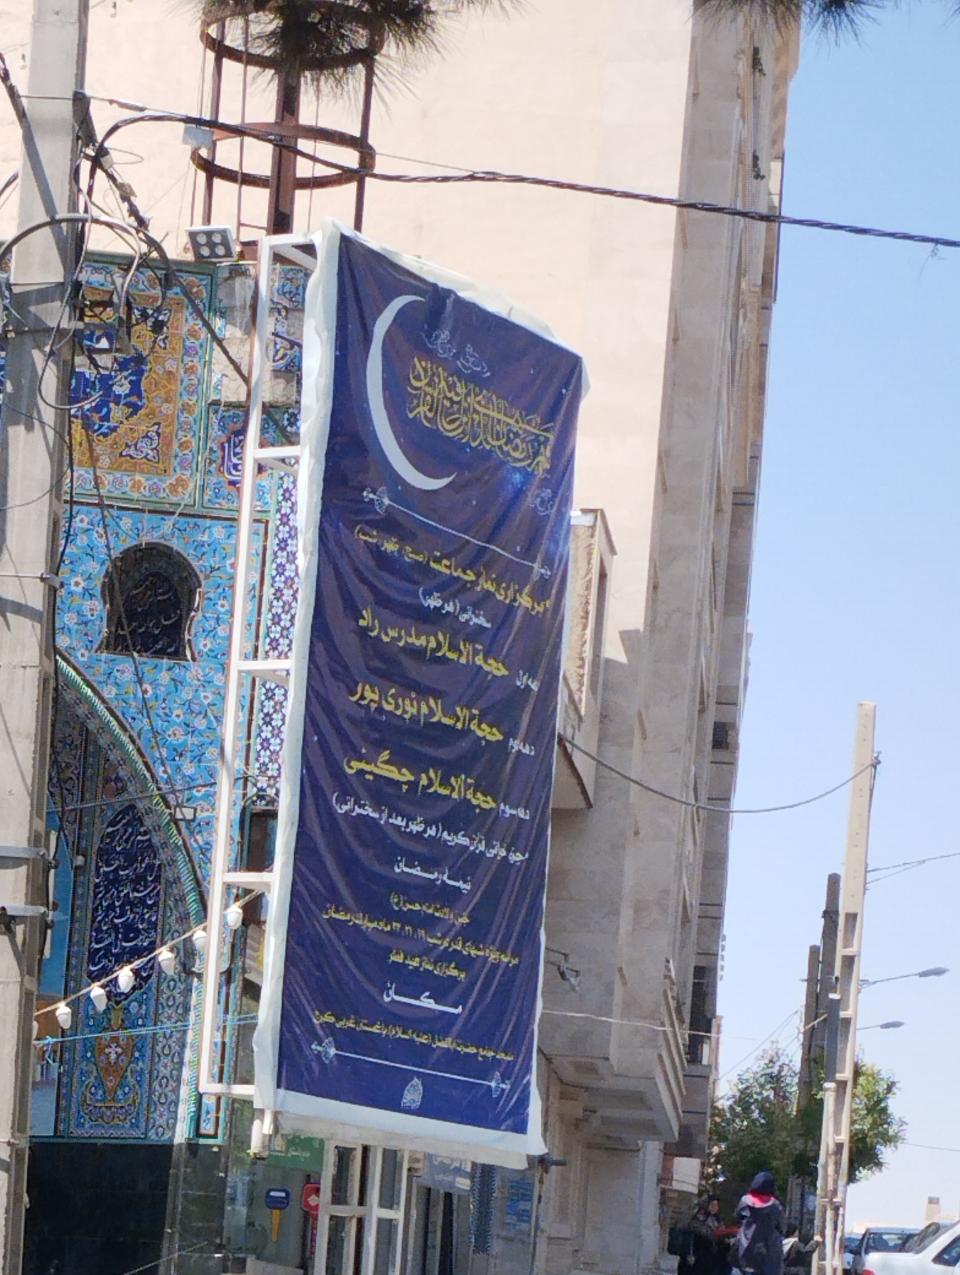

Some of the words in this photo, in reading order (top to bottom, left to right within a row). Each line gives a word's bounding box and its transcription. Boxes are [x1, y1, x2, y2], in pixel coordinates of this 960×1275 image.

[430, 551, 476, 587] جماعت
[427, 629, 473, 667] الاسلام
[475, 642, 509, 681] حجة
[382, 688, 418, 722] نوری
[419, 696, 469, 731] الاسلام
[470, 707, 504, 746] حجة
[343, 749, 415, 793] چگینی
[418, 766, 465, 802] الاسلام
[466, 777, 497, 813] حجة
[383, 979, 463, 1015] مکان
